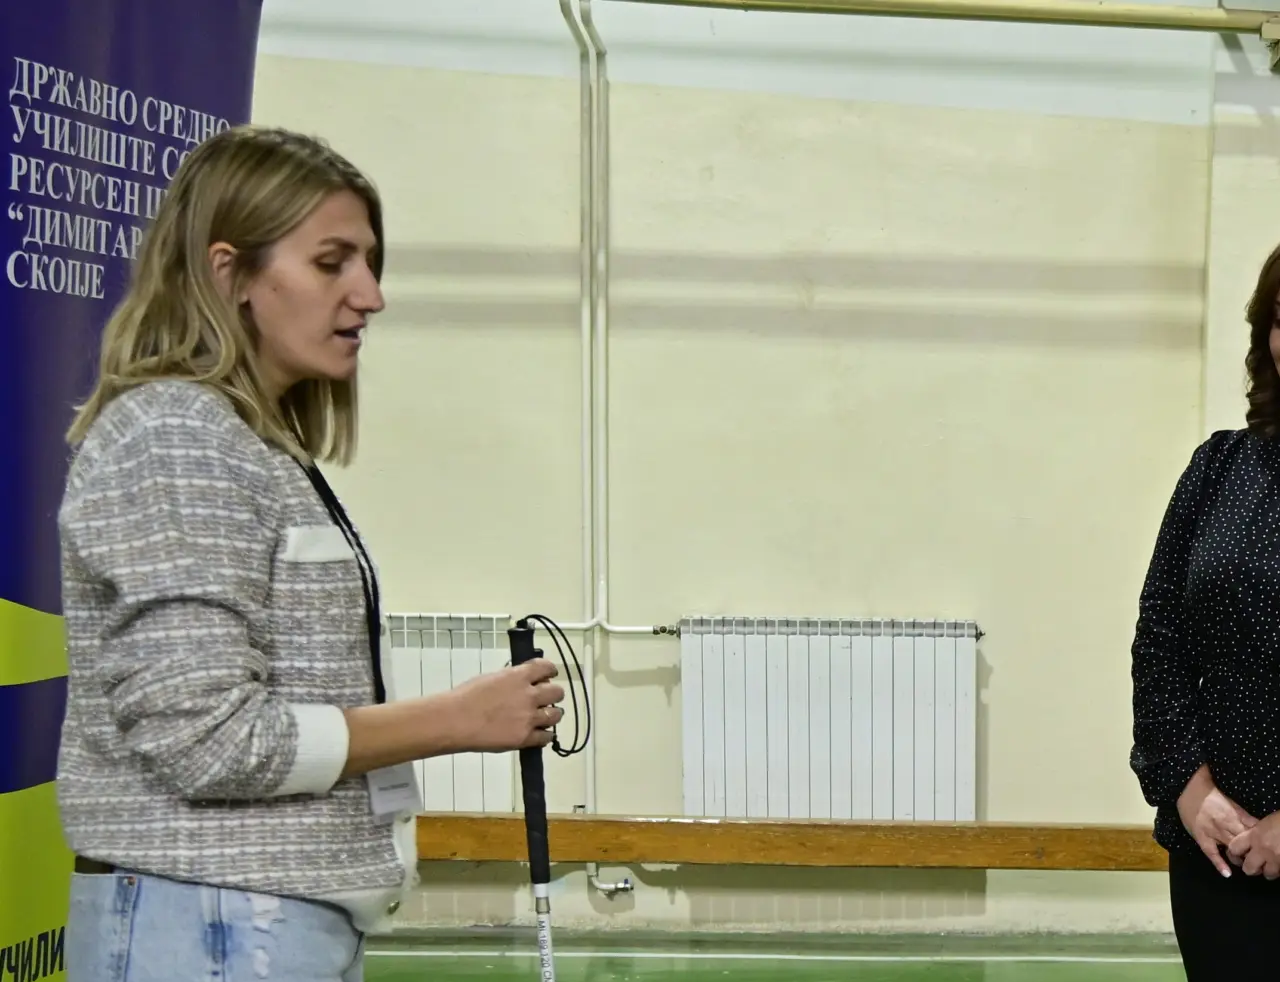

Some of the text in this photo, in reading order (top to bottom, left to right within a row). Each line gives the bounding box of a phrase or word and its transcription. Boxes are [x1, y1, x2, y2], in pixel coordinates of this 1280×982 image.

[9, 56, 138, 126] ДРЖАВНО
[9, 104, 156, 176] УЧИЛИШТЕ
[8, 153, 141, 216] РЕСУРСЕН
[6, 250, 105, 299] СКОПЈЕ
